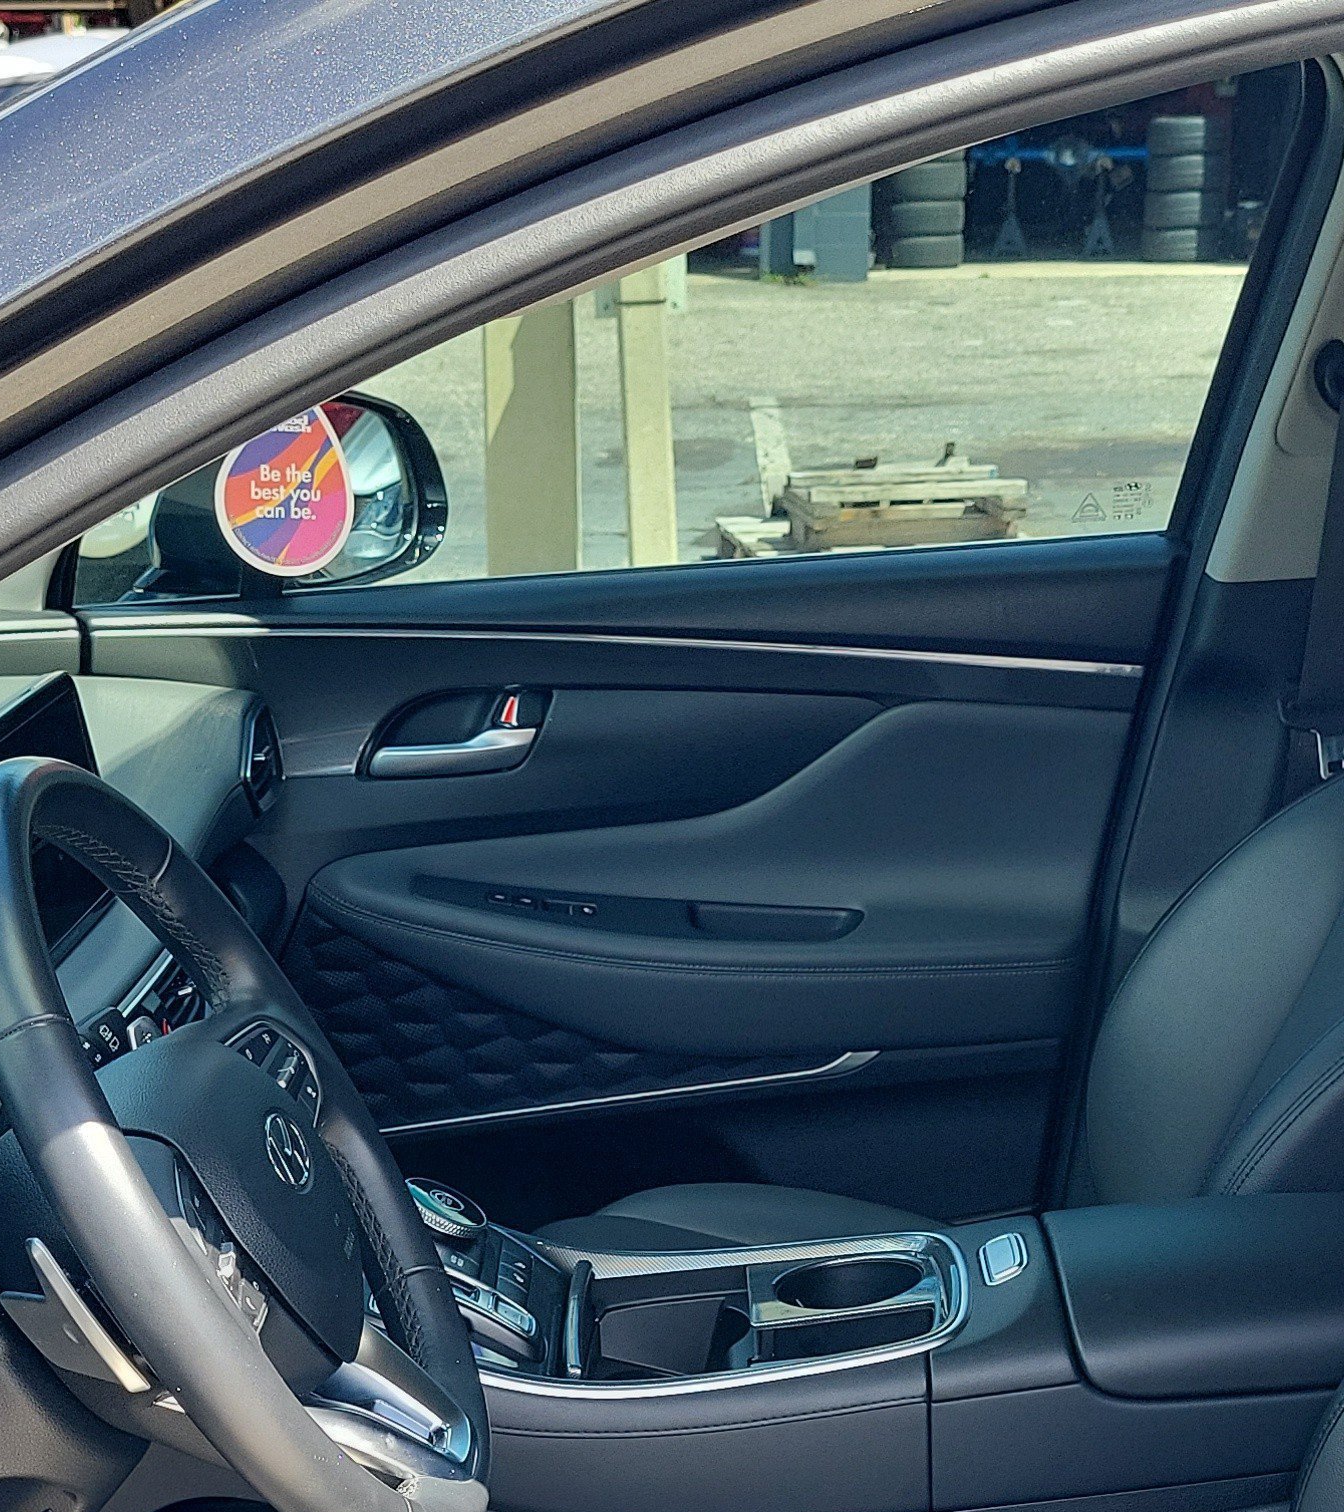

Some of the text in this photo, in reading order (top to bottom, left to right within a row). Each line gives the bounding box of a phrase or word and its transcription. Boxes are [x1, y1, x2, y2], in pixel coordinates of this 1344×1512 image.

[260, 463, 312, 483] Be the
[250, 480, 321, 507] best you
[256, 502, 317, 520] can be.
